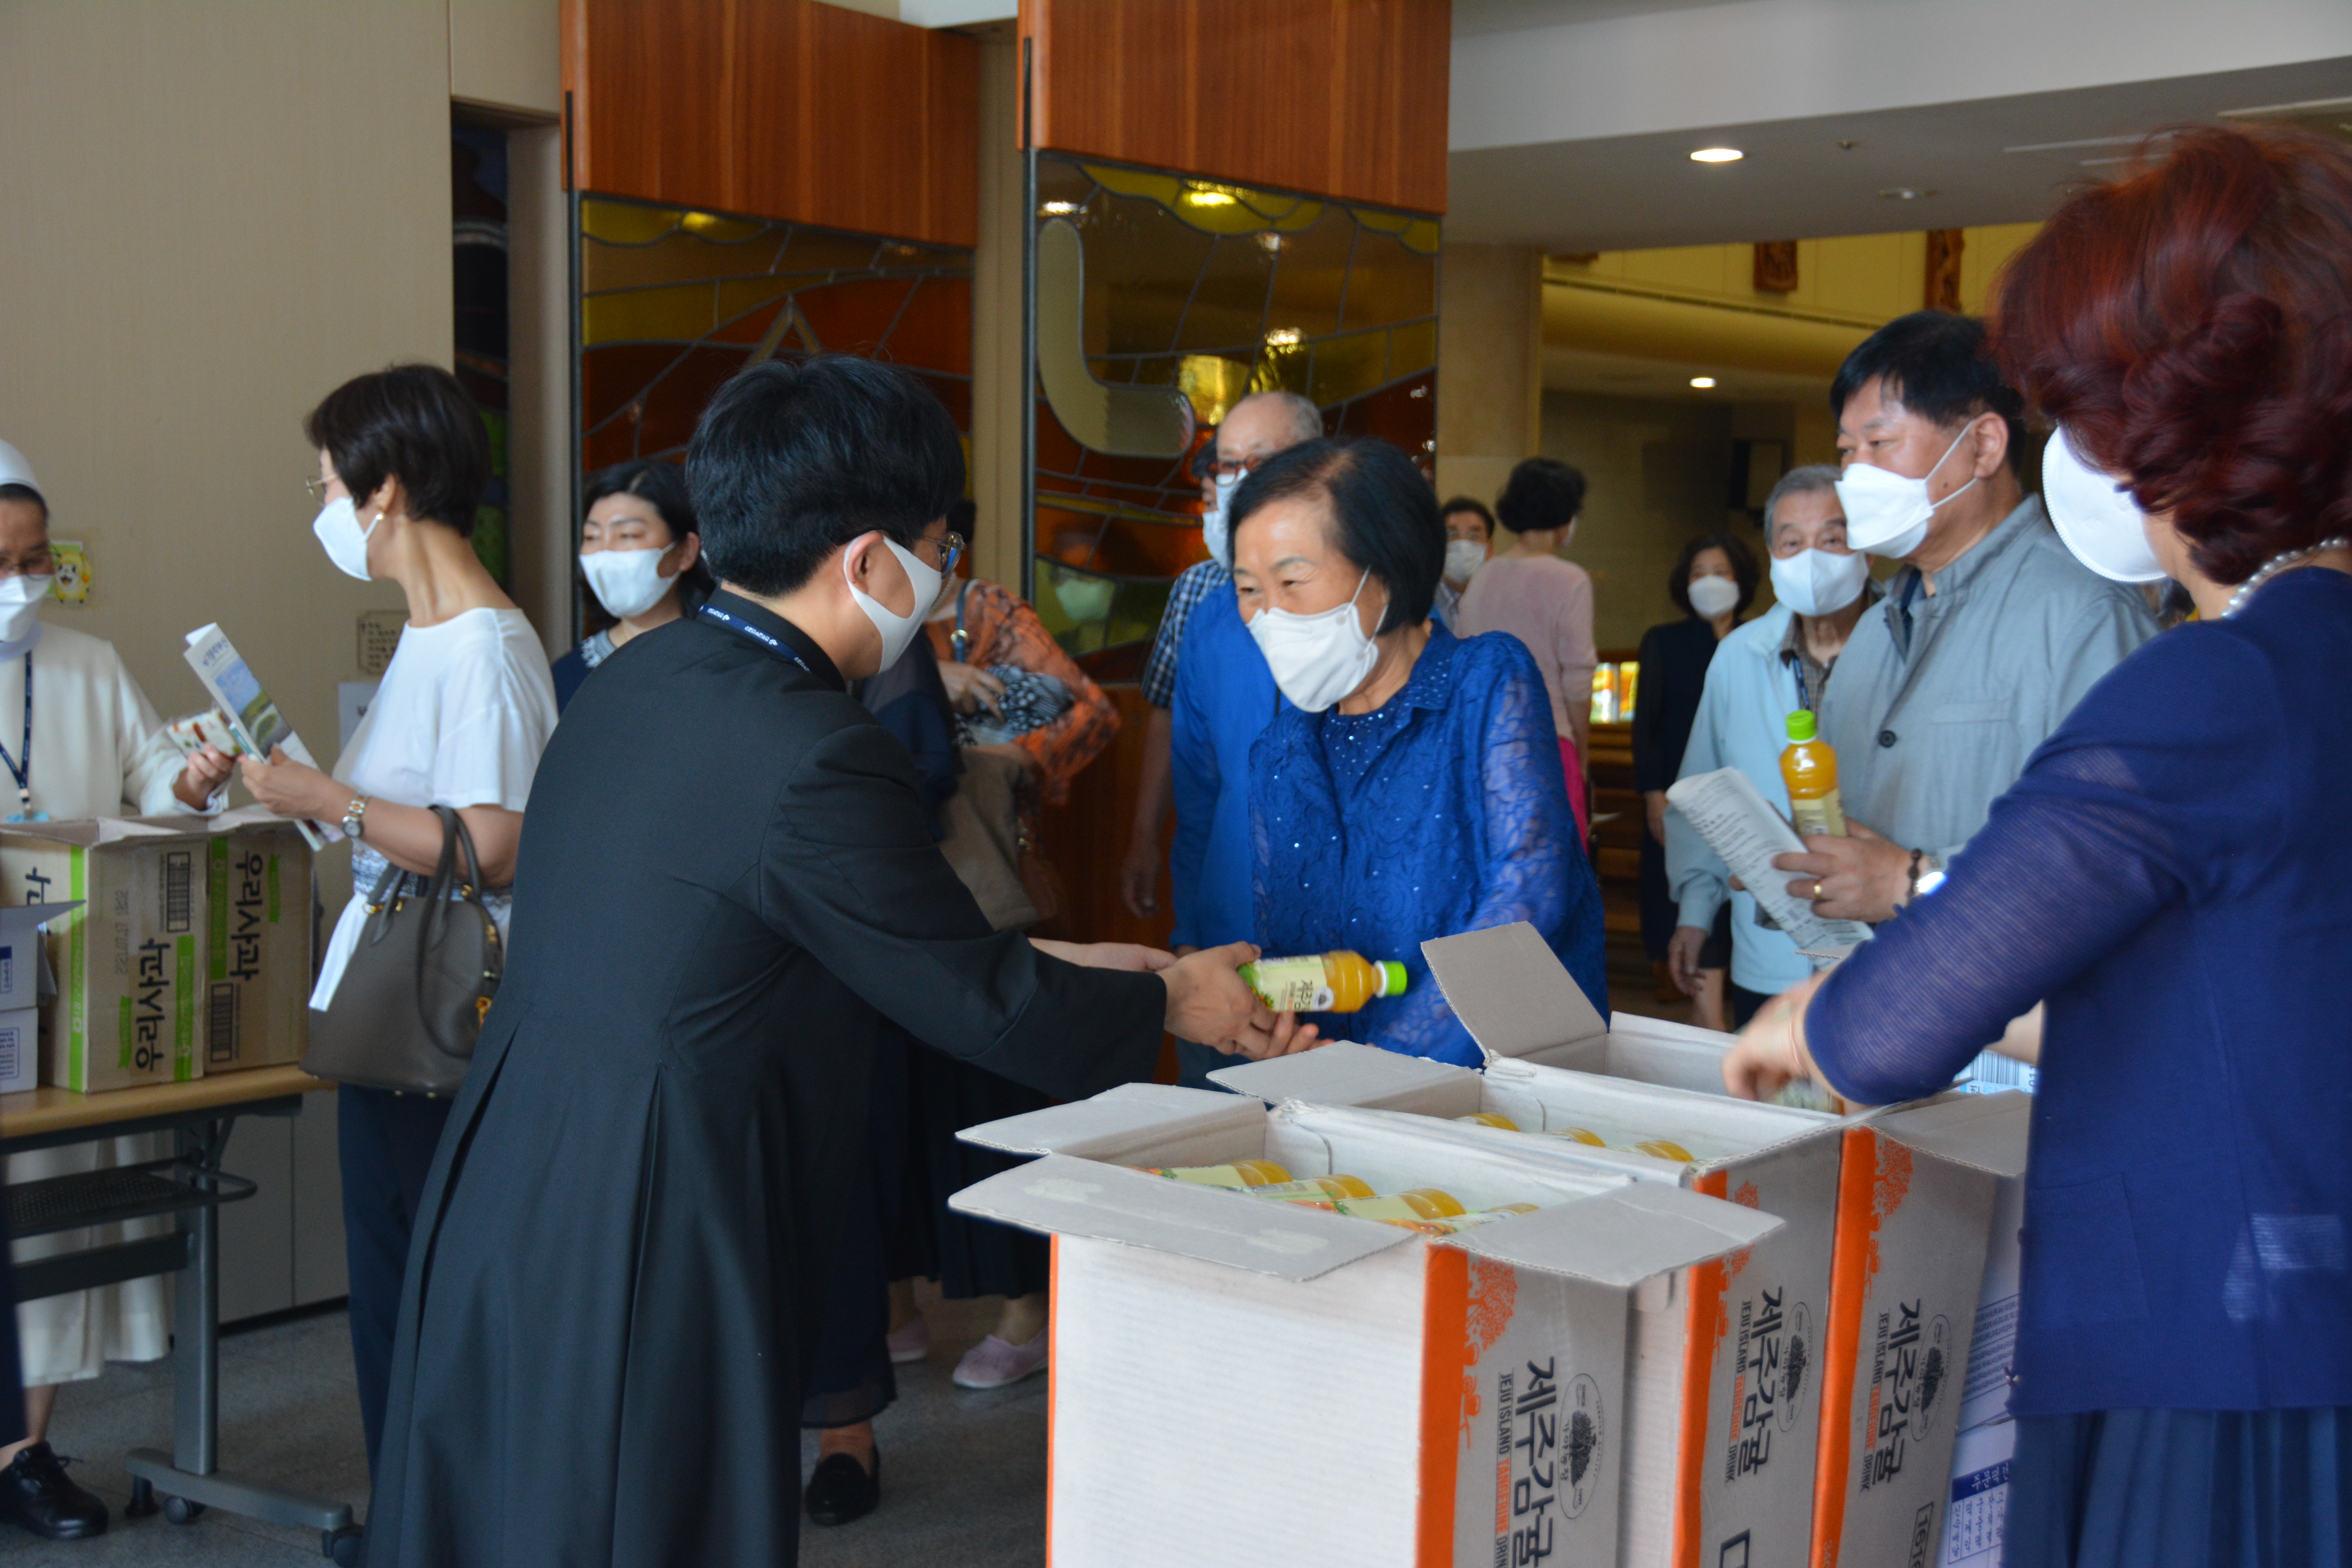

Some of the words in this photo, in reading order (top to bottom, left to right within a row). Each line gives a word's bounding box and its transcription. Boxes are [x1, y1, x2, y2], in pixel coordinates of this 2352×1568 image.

[230, 850, 265, 981] 우리사과
[135, 938, 171, 1072] 우리사과
[1740, 1300, 1752, 1328] JEJU
[1878, 1313, 1889, 1339] JEJU
[1736, 1329, 1749, 1374] ISLAND
[1873, 1341, 1886, 1384] ISLAND
[1499, 1373, 1512, 1403] JEJU
[1729, 1374, 1744, 1443] TANGERINE
[1737, 1285, 1782, 1477] 제주감귤
[1872, 1298, 1920, 1485] 제주감귤
[1499, 1405, 1511, 1455] ISLAND
[1865, 1384, 1880, 1451] TANGERINE
[1512, 1356, 1557, 1568] 제주감귤
[1725, 1445, 1737, 1483] DRINK
[1860, 1454, 1873, 1492] DRINK
[1496, 1456, 1510, 1535] TANGERINE
